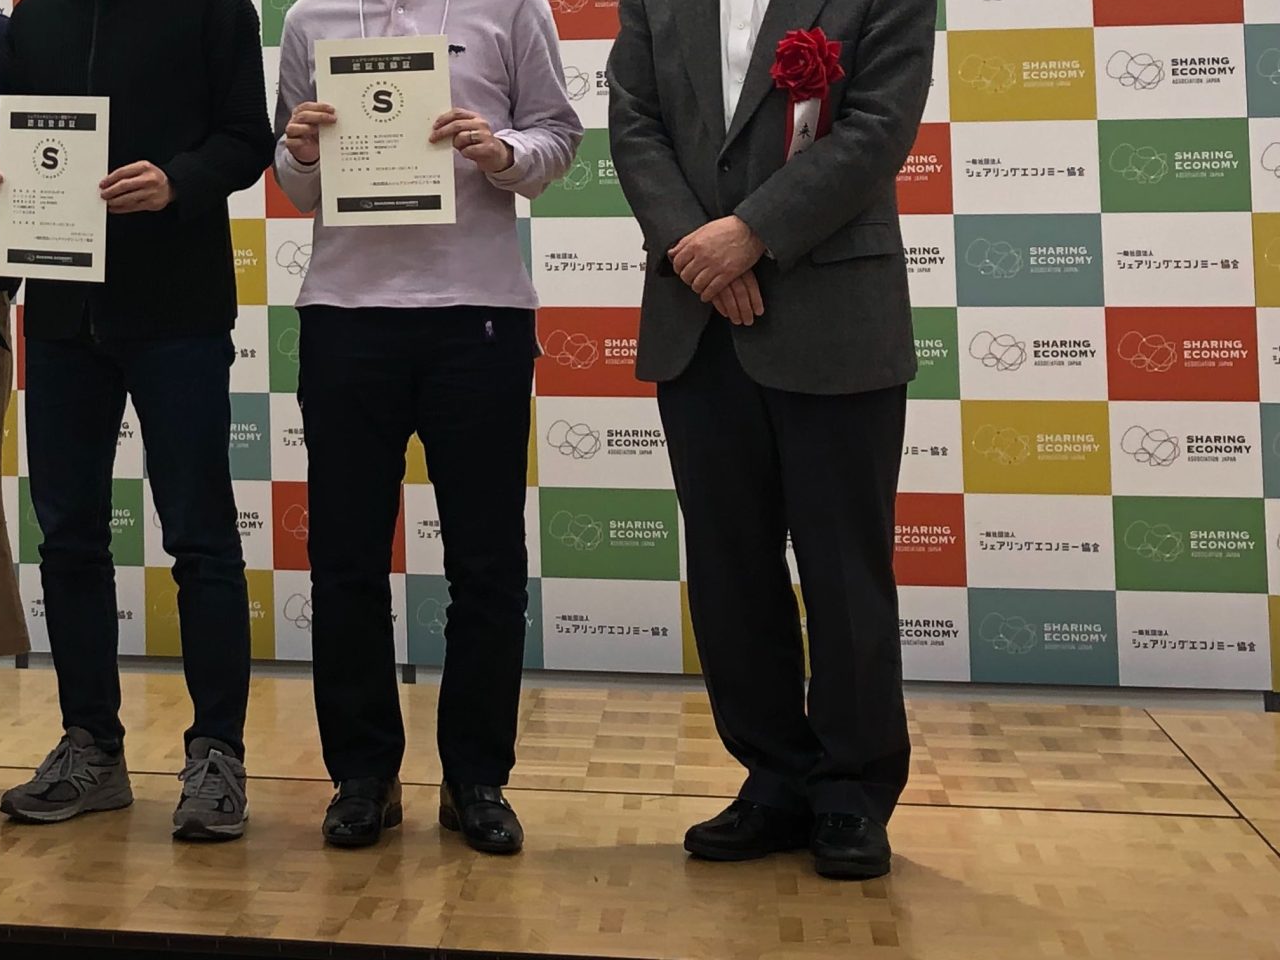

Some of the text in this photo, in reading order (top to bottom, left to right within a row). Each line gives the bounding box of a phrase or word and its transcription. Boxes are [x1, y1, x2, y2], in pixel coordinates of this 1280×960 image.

[1022, 60, 1079, 69] SHARING
[1171, 56, 1229, 65] SHARING
[1022, 70, 1085, 79] ECONOMY
[1171, 66, 1235, 75] ECONOMY
[372, 90, 393, 113] S
[40, 147, 59, 170] S
[1174, 150, 1233, 159] SHARING
[1174, 160, 1239, 169] ECONOMY
[1029, 246, 1087, 254] SHARING
[1029, 256, 1093, 264] ECONOMY
[1032, 339, 1090, 347] SHARING
[1183, 340, 1242, 348] SHARING
[1033, 349, 1096, 357] ECONOMY
[1183, 350, 1248, 358] ECONOMY
[606, 429, 660, 437] SHARING
[606, 439, 665, 447] ECONOMY
[1186, 435, 1245, 443] SHARING
[1186, 445, 1251, 453] ECONOMY
[609, 520, 663, 529] SHARING
[609, 530, 668, 538] ECONOMY
[1189, 530, 1249, 539] SHARING
[1190, 540, 1255, 550] ECONOMY
[1043, 622, 1101, 632] SHARING
[1043, 632, 1107, 642] ECONOMY
